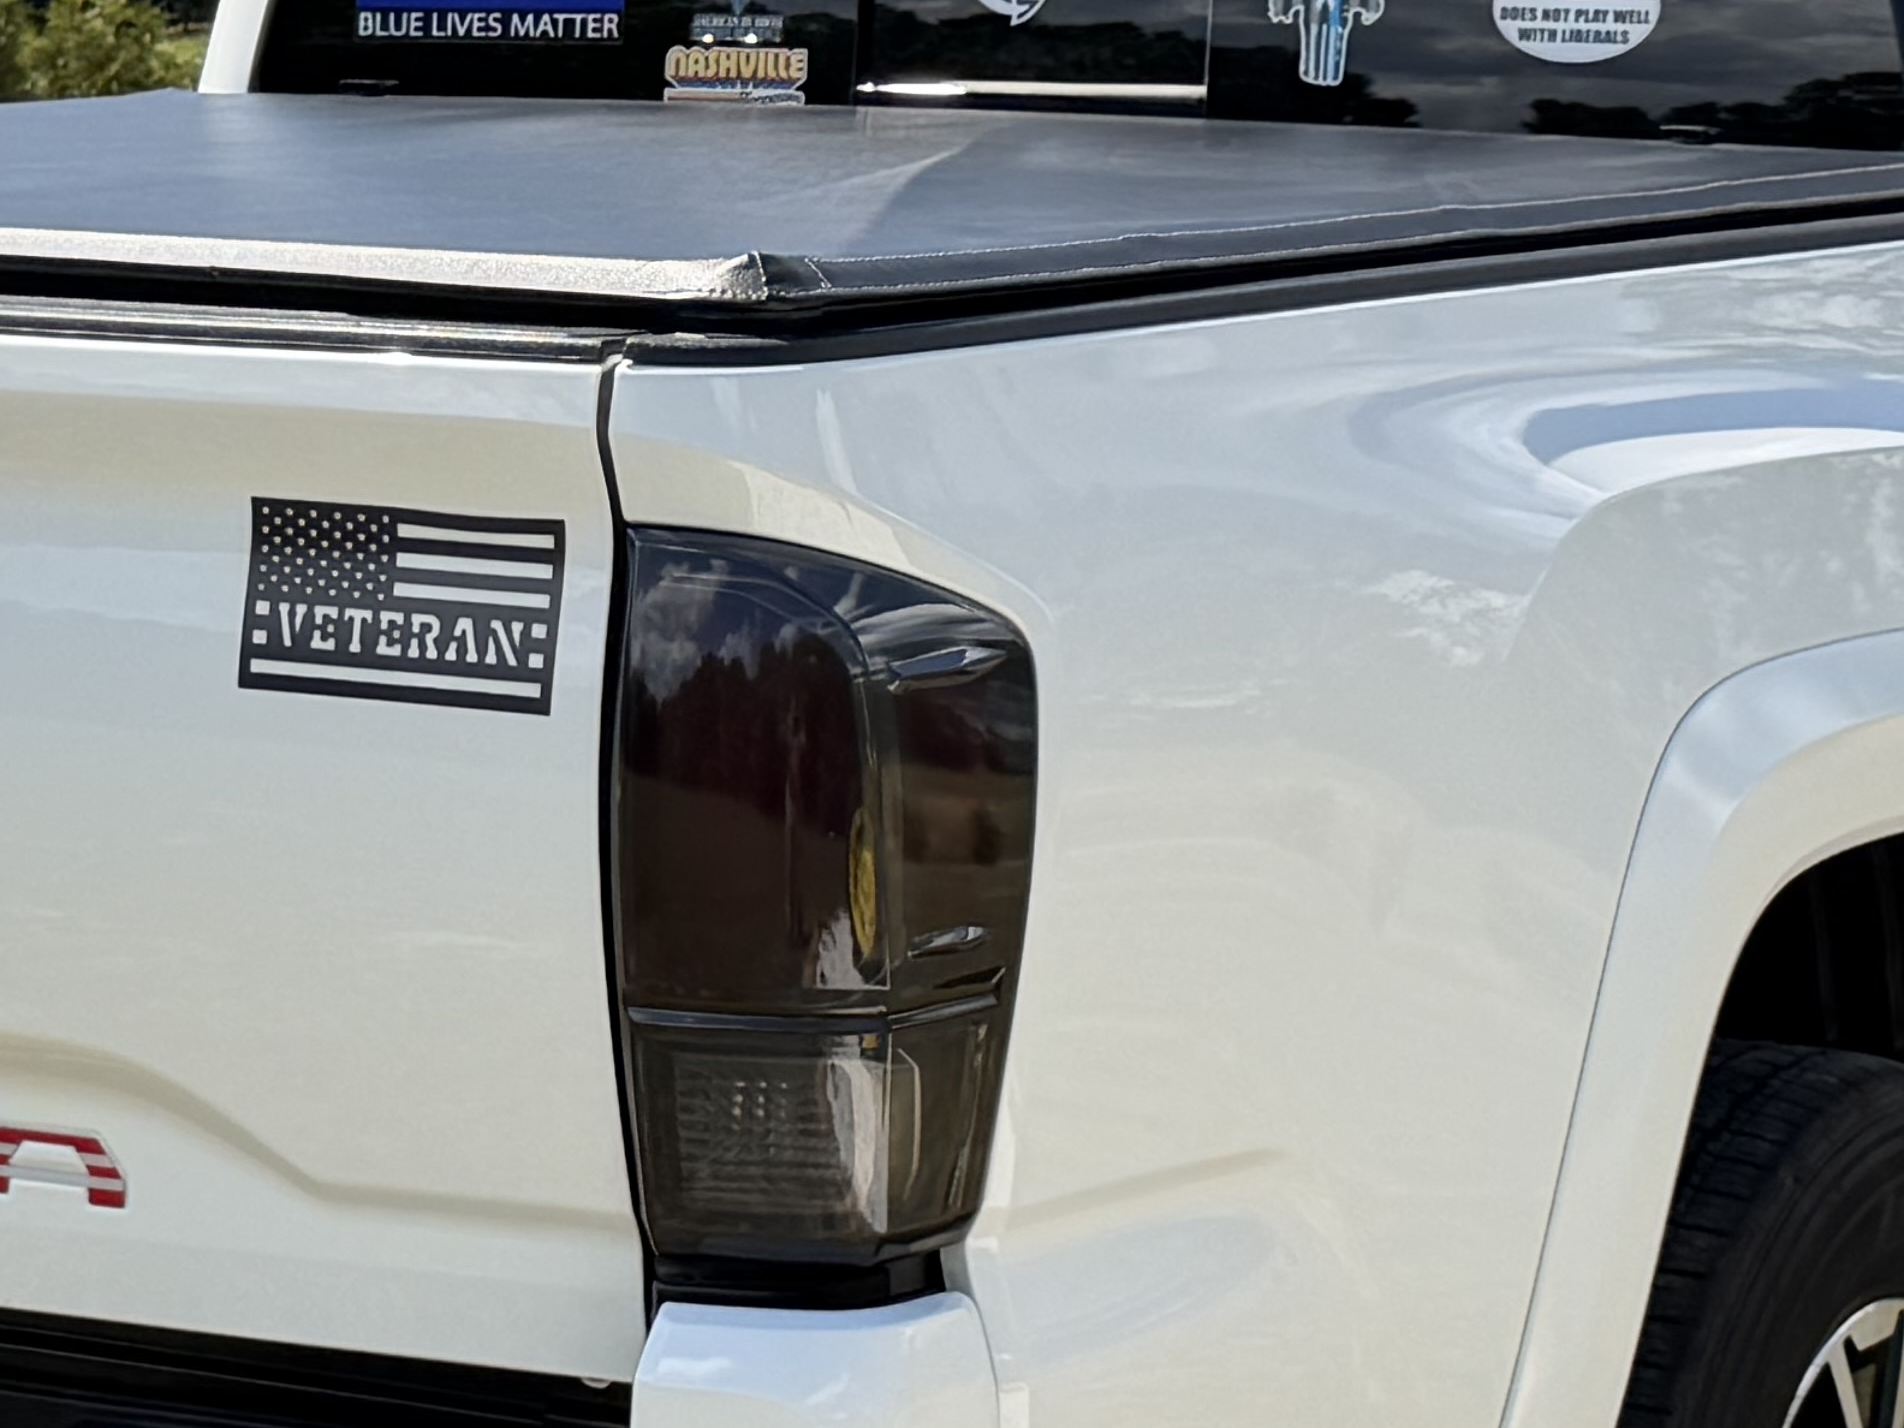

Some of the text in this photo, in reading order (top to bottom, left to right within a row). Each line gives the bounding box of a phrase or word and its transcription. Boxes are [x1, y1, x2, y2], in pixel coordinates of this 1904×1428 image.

[358, 12, 619, 39] BLUE LIVES MATTER
[1499, 6, 1650, 24] DOES NOT PLAY WELL
[1518, 28, 1630, 44] WITH LIBERALS
[670, 49, 805, 80] NASHVILLE
[278, 602, 524, 667] VETERAN
